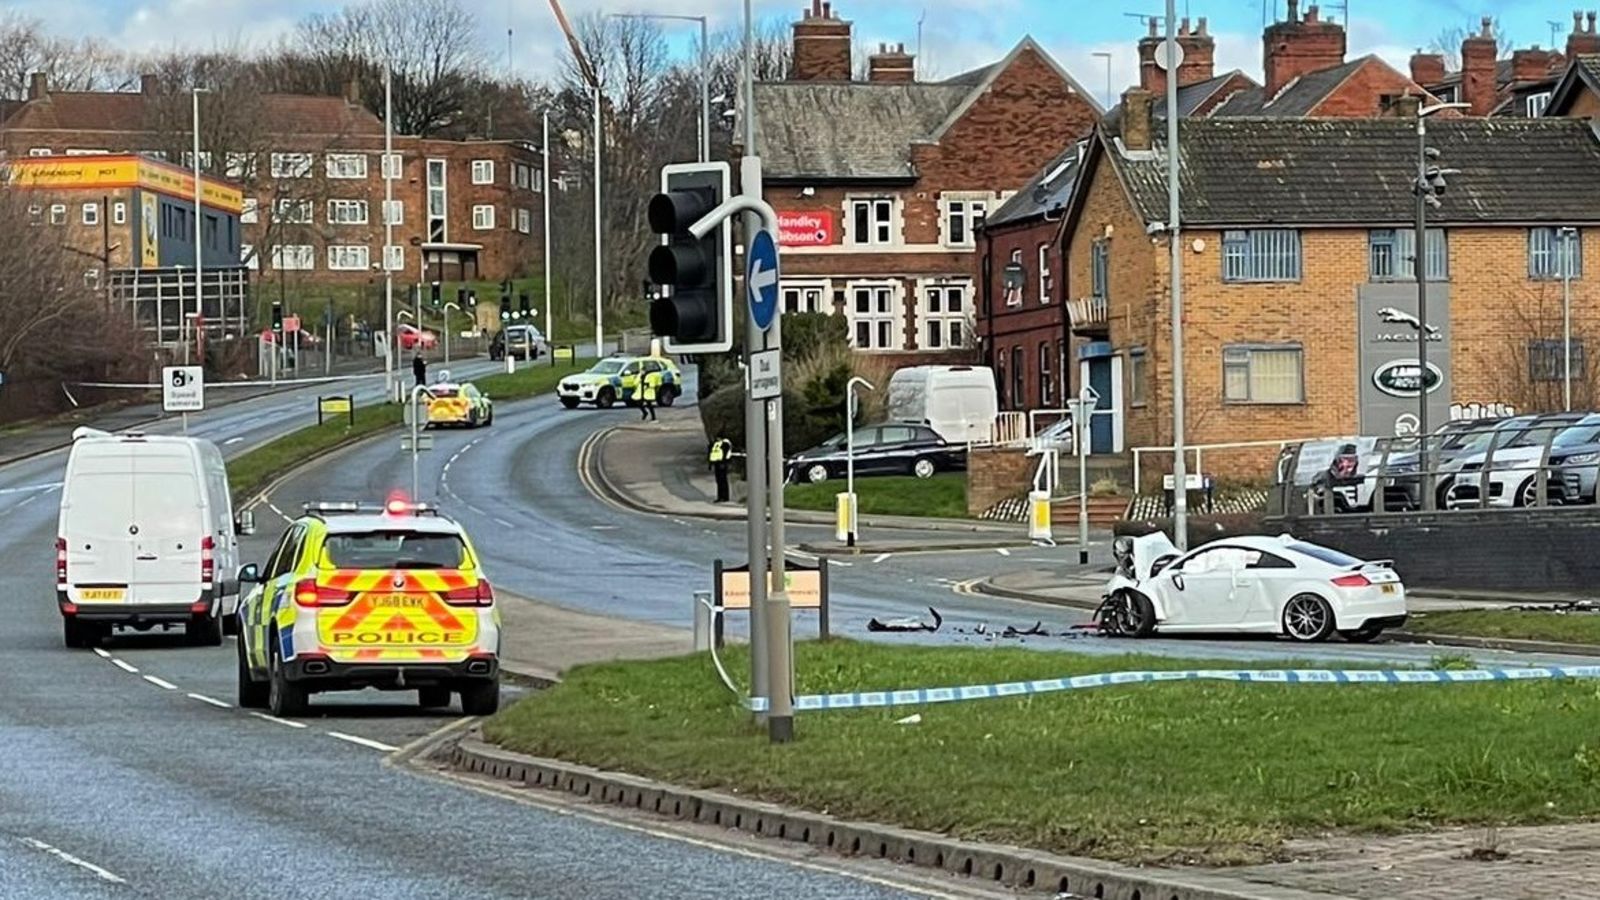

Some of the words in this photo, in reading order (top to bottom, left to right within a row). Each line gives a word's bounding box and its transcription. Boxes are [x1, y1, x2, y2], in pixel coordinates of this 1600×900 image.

[778, 230, 815, 241] ibson
[1376, 333, 1443, 341] JAGUR
[333, 632, 464, 643] POLICE
